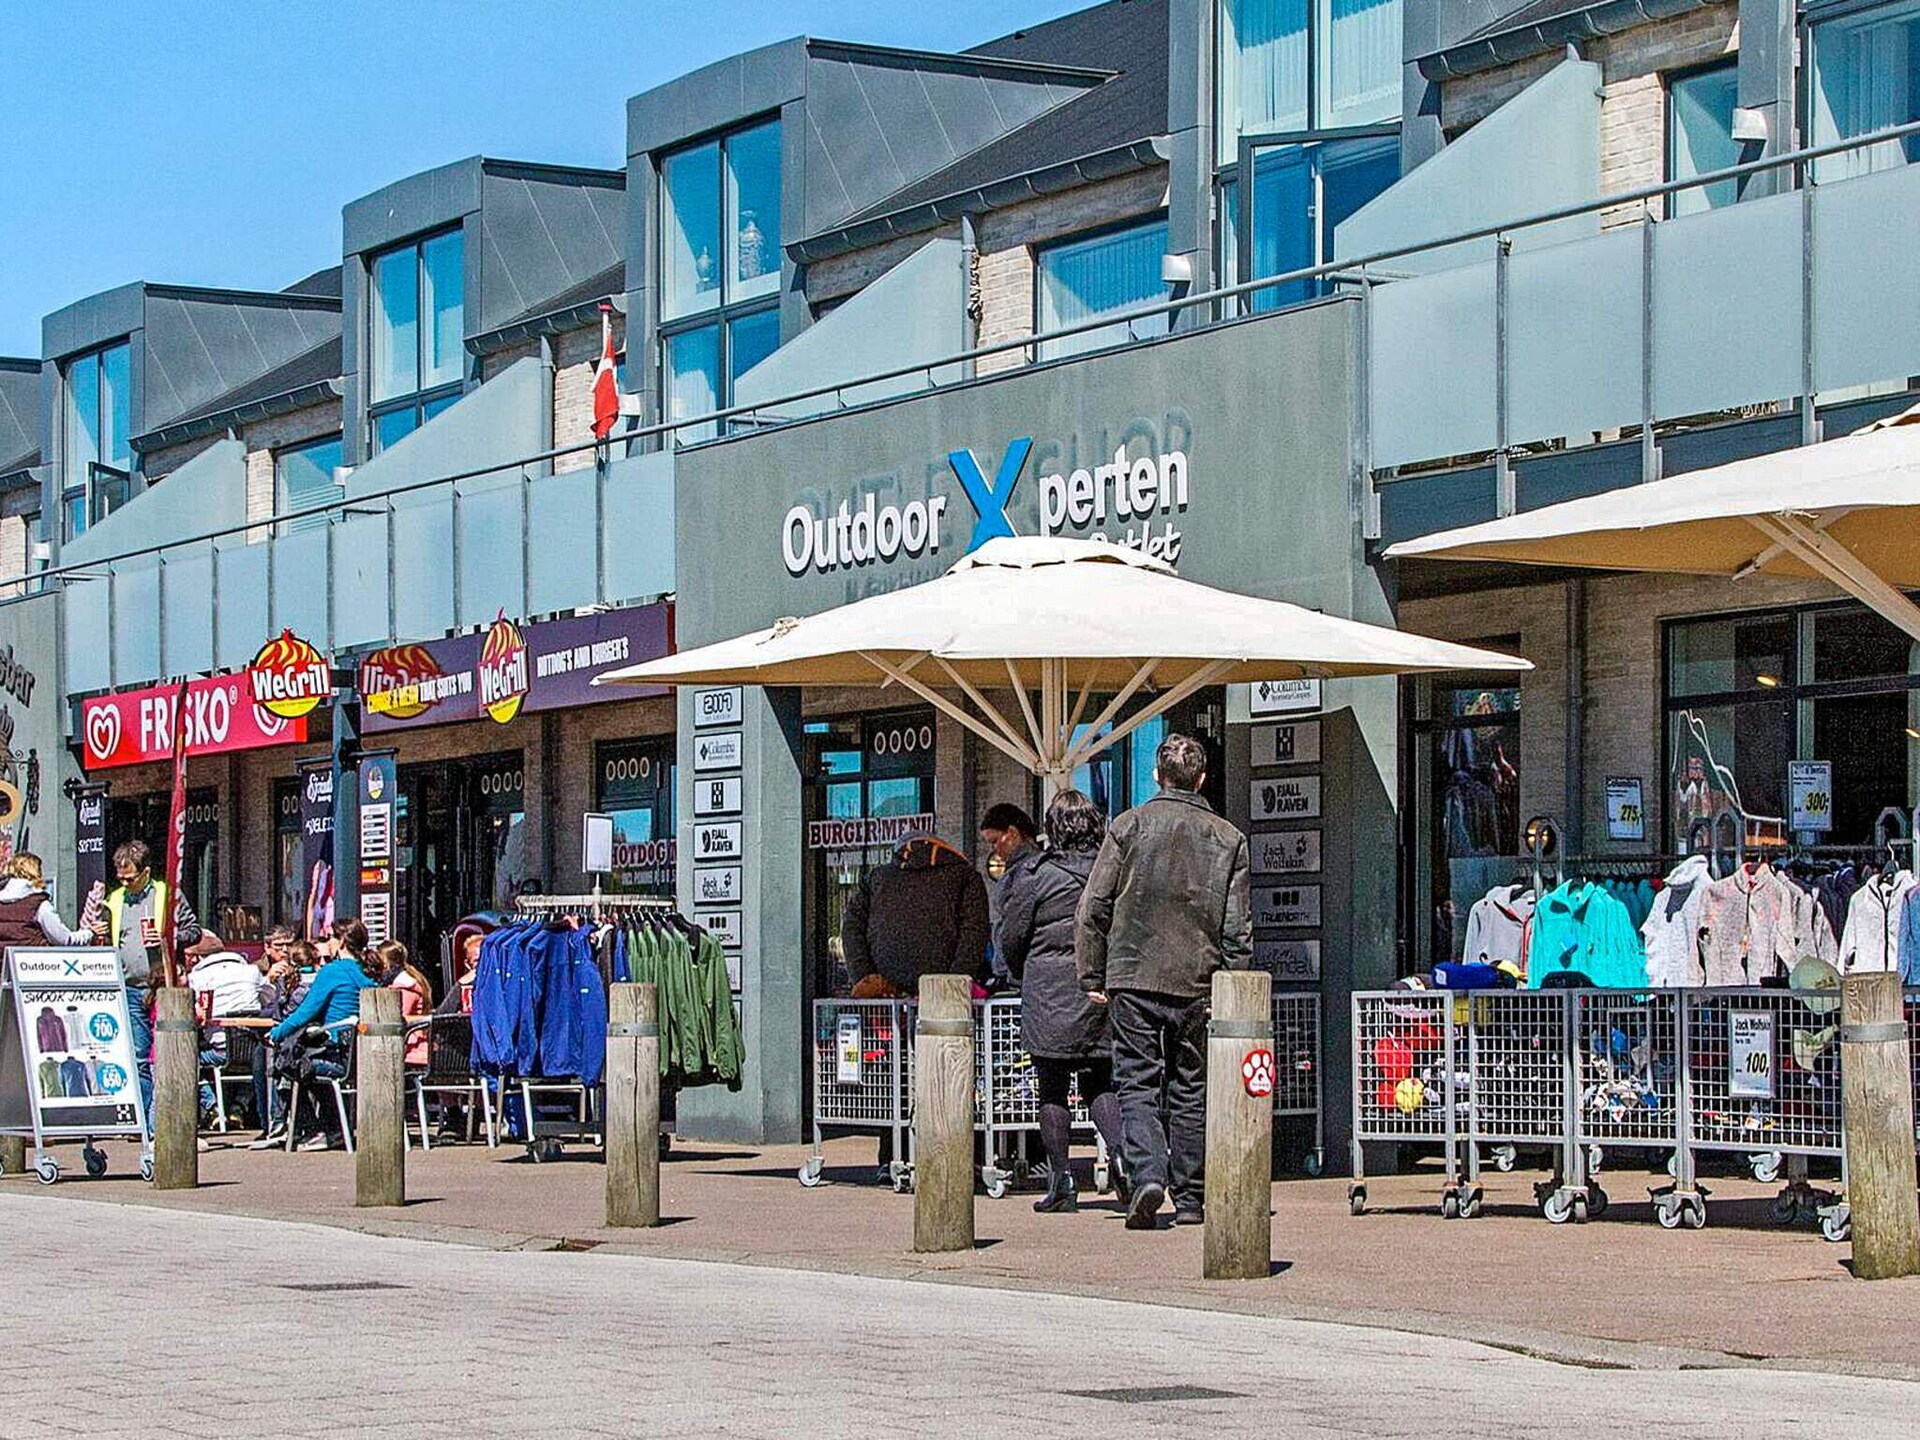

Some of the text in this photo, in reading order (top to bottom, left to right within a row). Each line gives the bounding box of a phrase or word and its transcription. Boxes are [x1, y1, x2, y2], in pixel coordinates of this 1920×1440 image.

[782, 436, 1188, 573] Outdoor X perten
[1089, 520, 1182, 561] tlet
[251, 663, 330, 702] WeGrill
[480, 650, 527, 705] WeGrill
[809, 819, 880, 849] BURGER
[20, 962, 61, 972] Outdoor
[62, 959, 83, 976] X
[82, 962, 114, 973] perten
